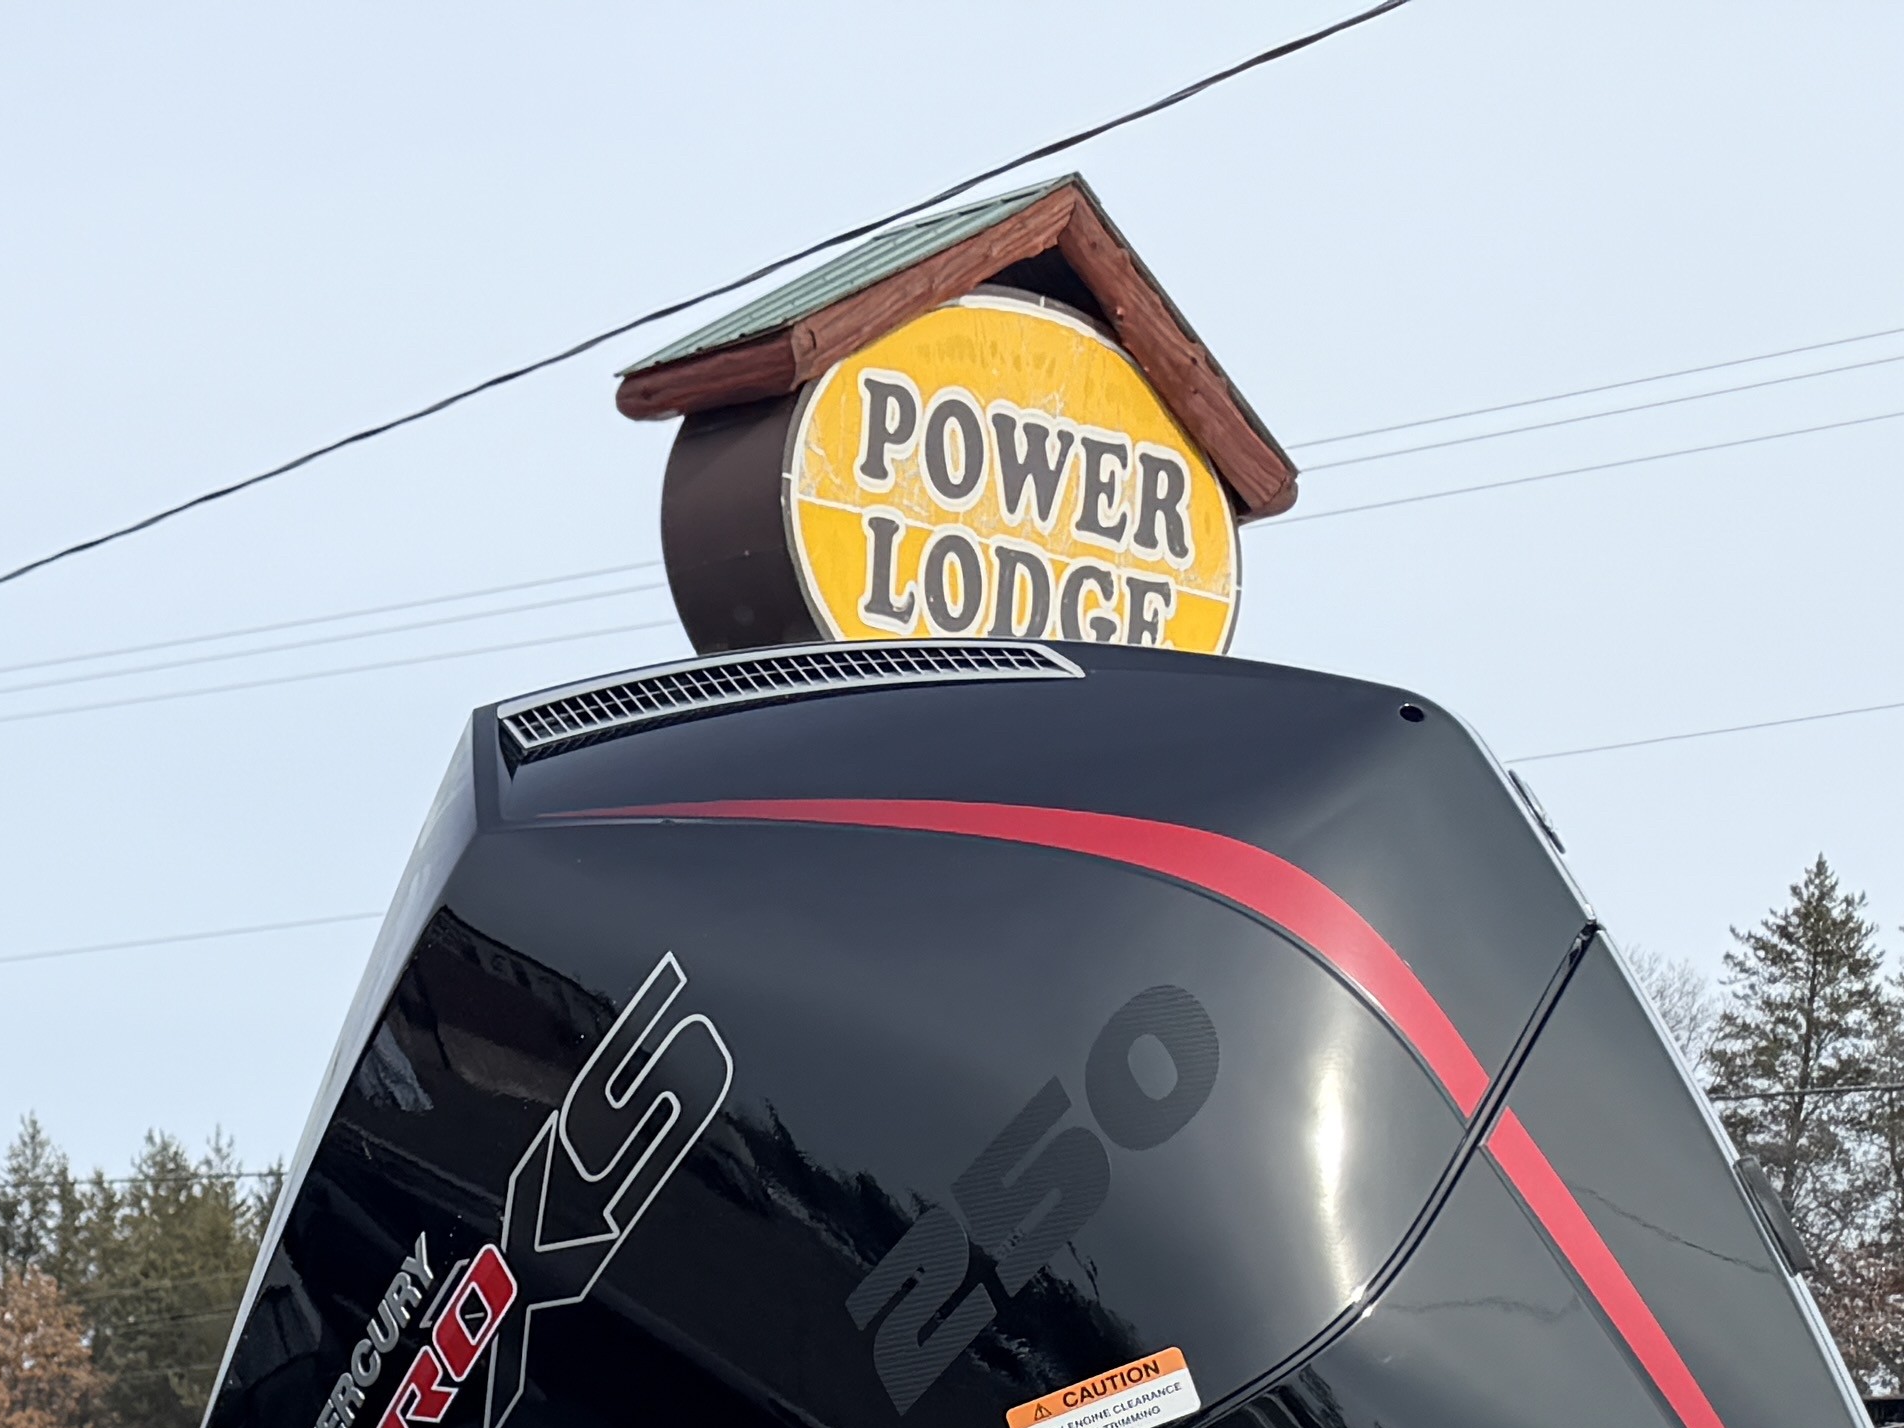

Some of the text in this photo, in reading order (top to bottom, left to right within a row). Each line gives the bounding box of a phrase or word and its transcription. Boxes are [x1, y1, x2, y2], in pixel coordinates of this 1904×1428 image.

[856, 373, 1191, 562] POWER
[861, 513, 1176, 646] LODGE
[845, 984, 1220, 1417] 250
[1062, 1359, 1160, 1408] CAUTION
[1112, 1381, 1183, 1417] CLEARANCE
